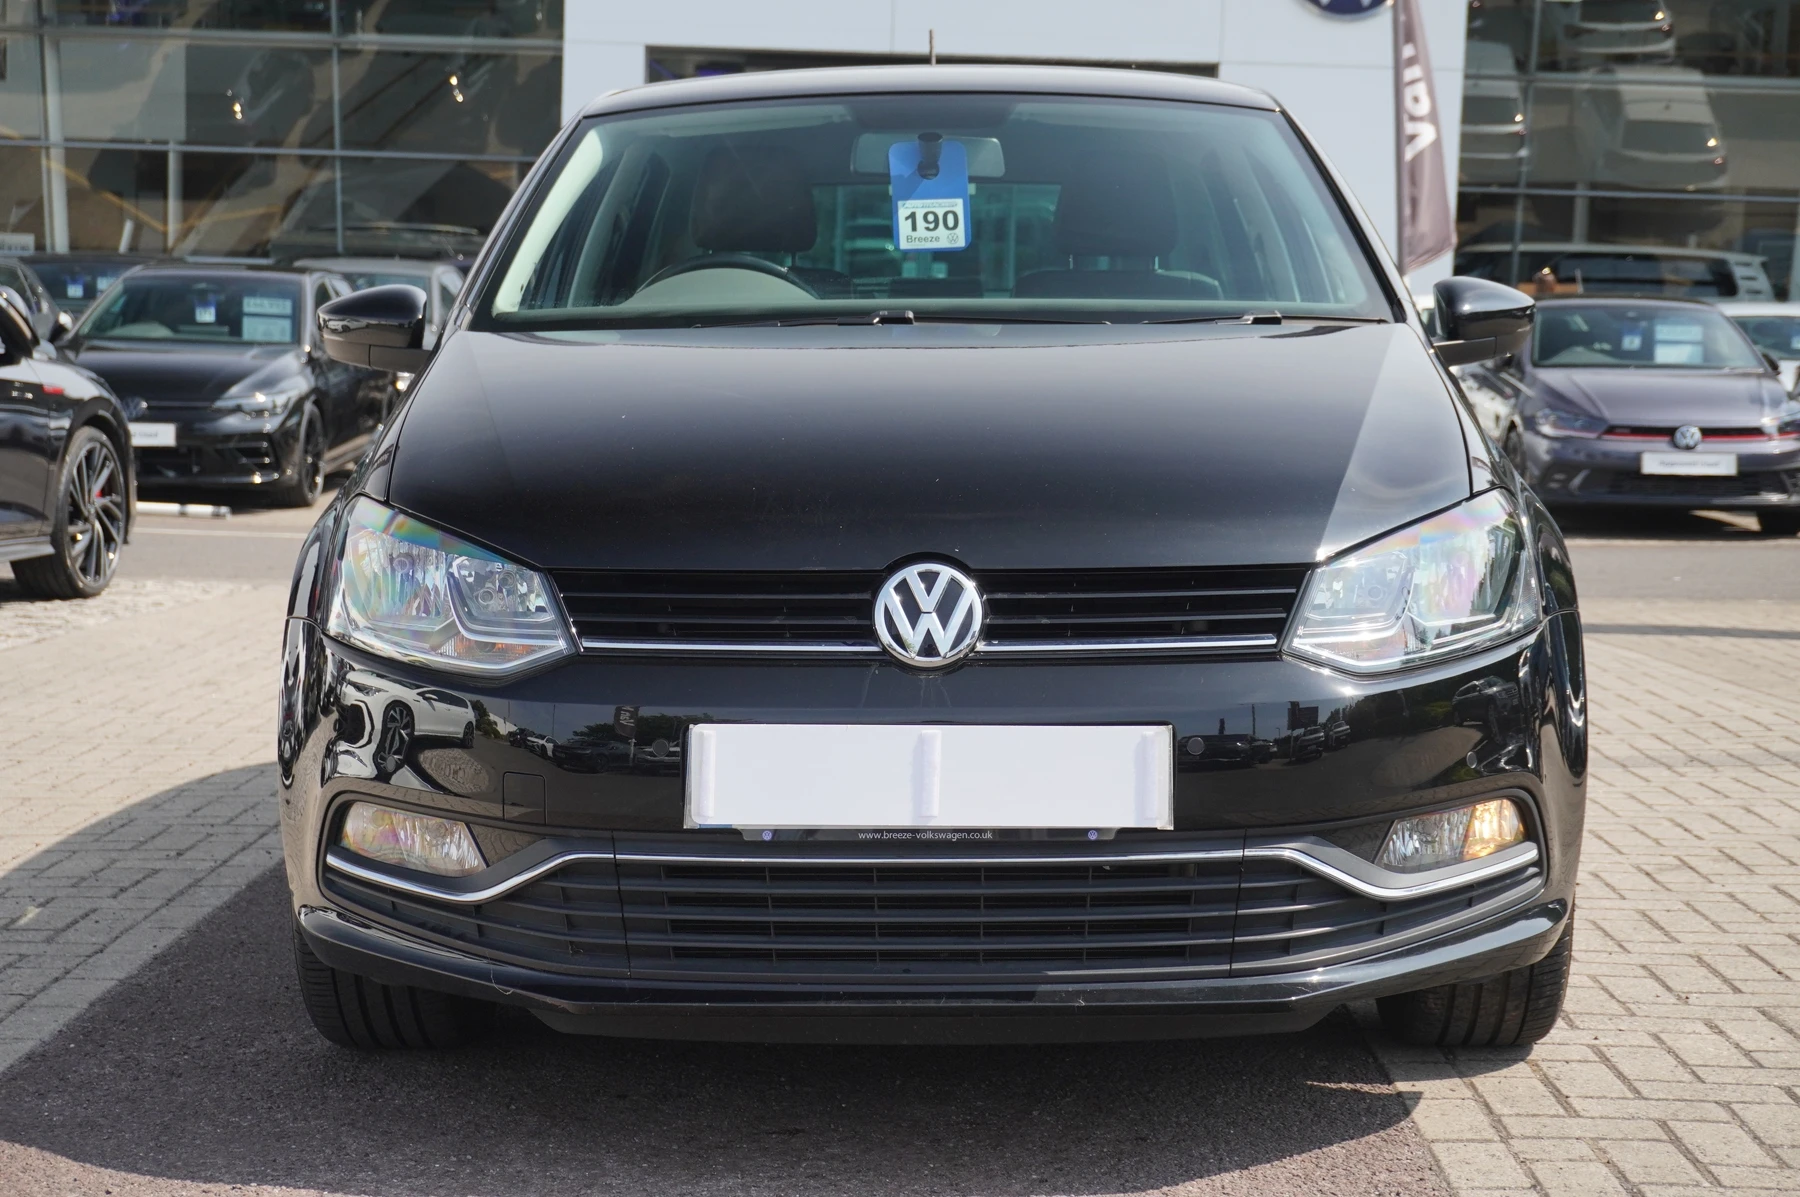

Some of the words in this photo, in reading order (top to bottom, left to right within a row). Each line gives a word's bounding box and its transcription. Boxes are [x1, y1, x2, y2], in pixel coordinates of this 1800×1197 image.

[904, 210, 959, 232] 190
[906, 234, 941, 244] Breeze
[858, 831, 993, 841] www.breeze-volkswagen.co.uk
